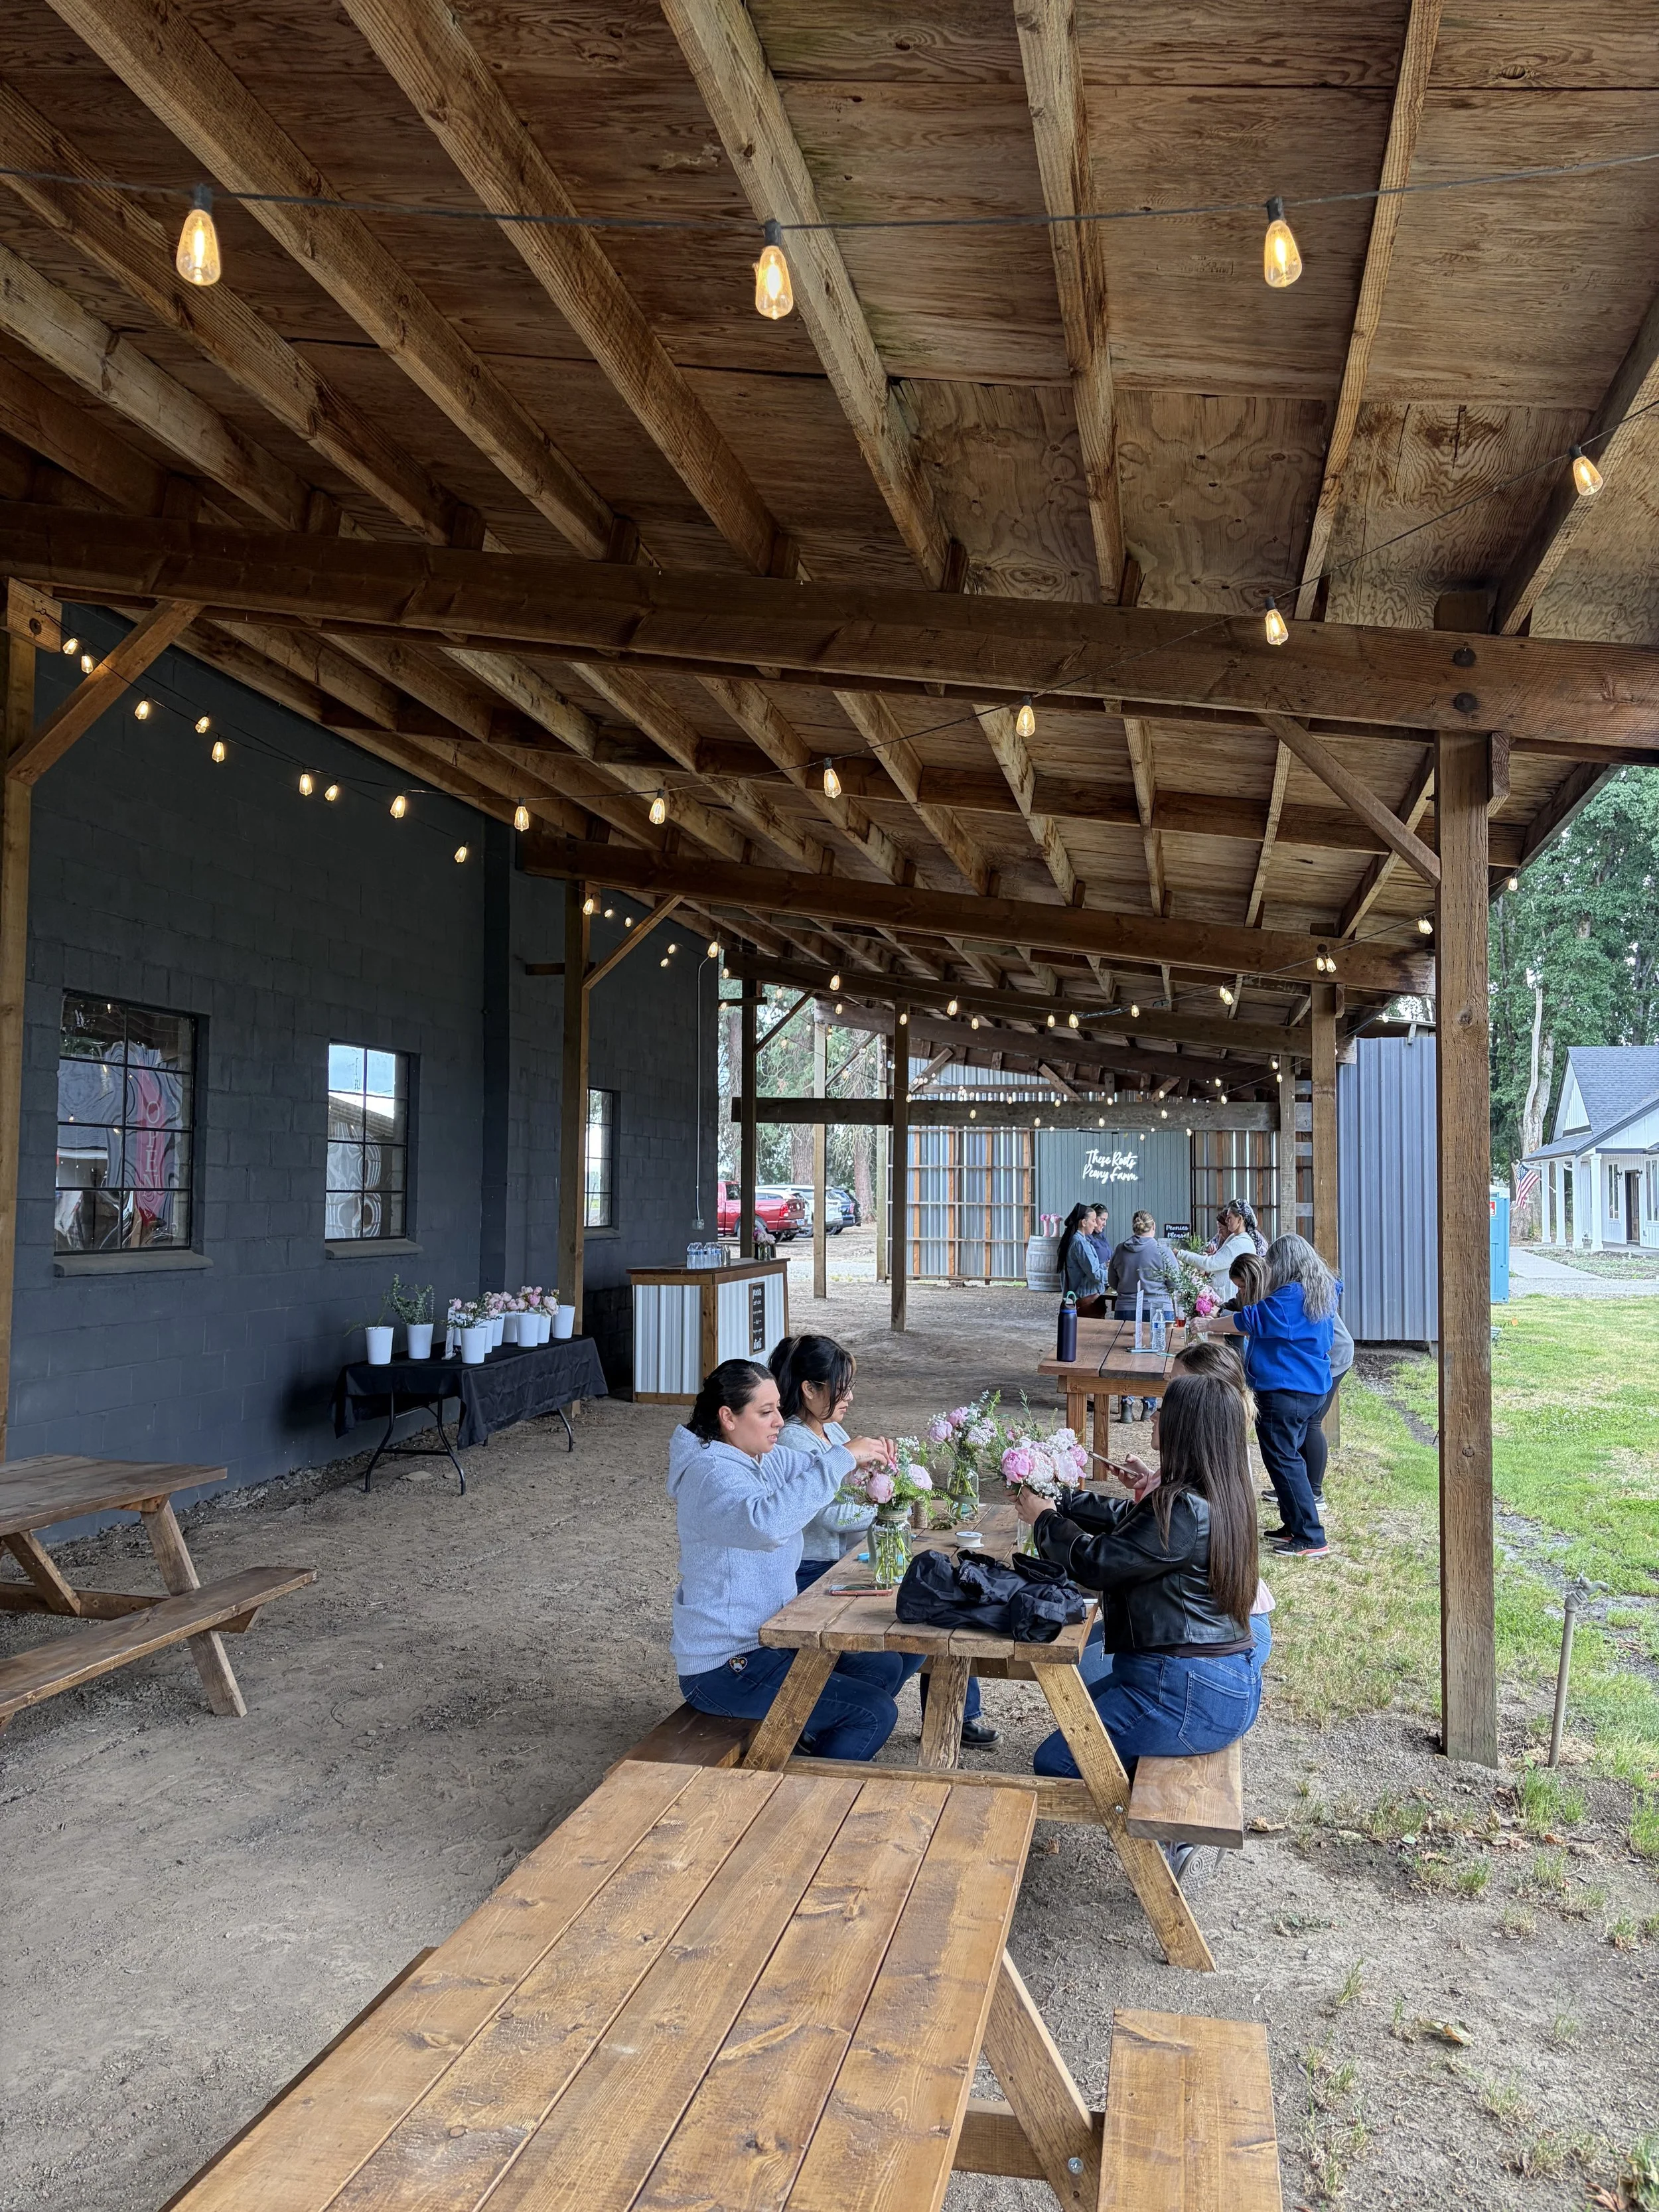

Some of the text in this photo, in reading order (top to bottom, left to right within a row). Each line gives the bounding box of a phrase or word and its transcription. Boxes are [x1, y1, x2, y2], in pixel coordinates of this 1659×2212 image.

[142, 1101, 161, 1196] OPEN
[1086, 1149, 1138, 1169] These Roots
[1082, 1164, 1139, 1184] Peony Farm
